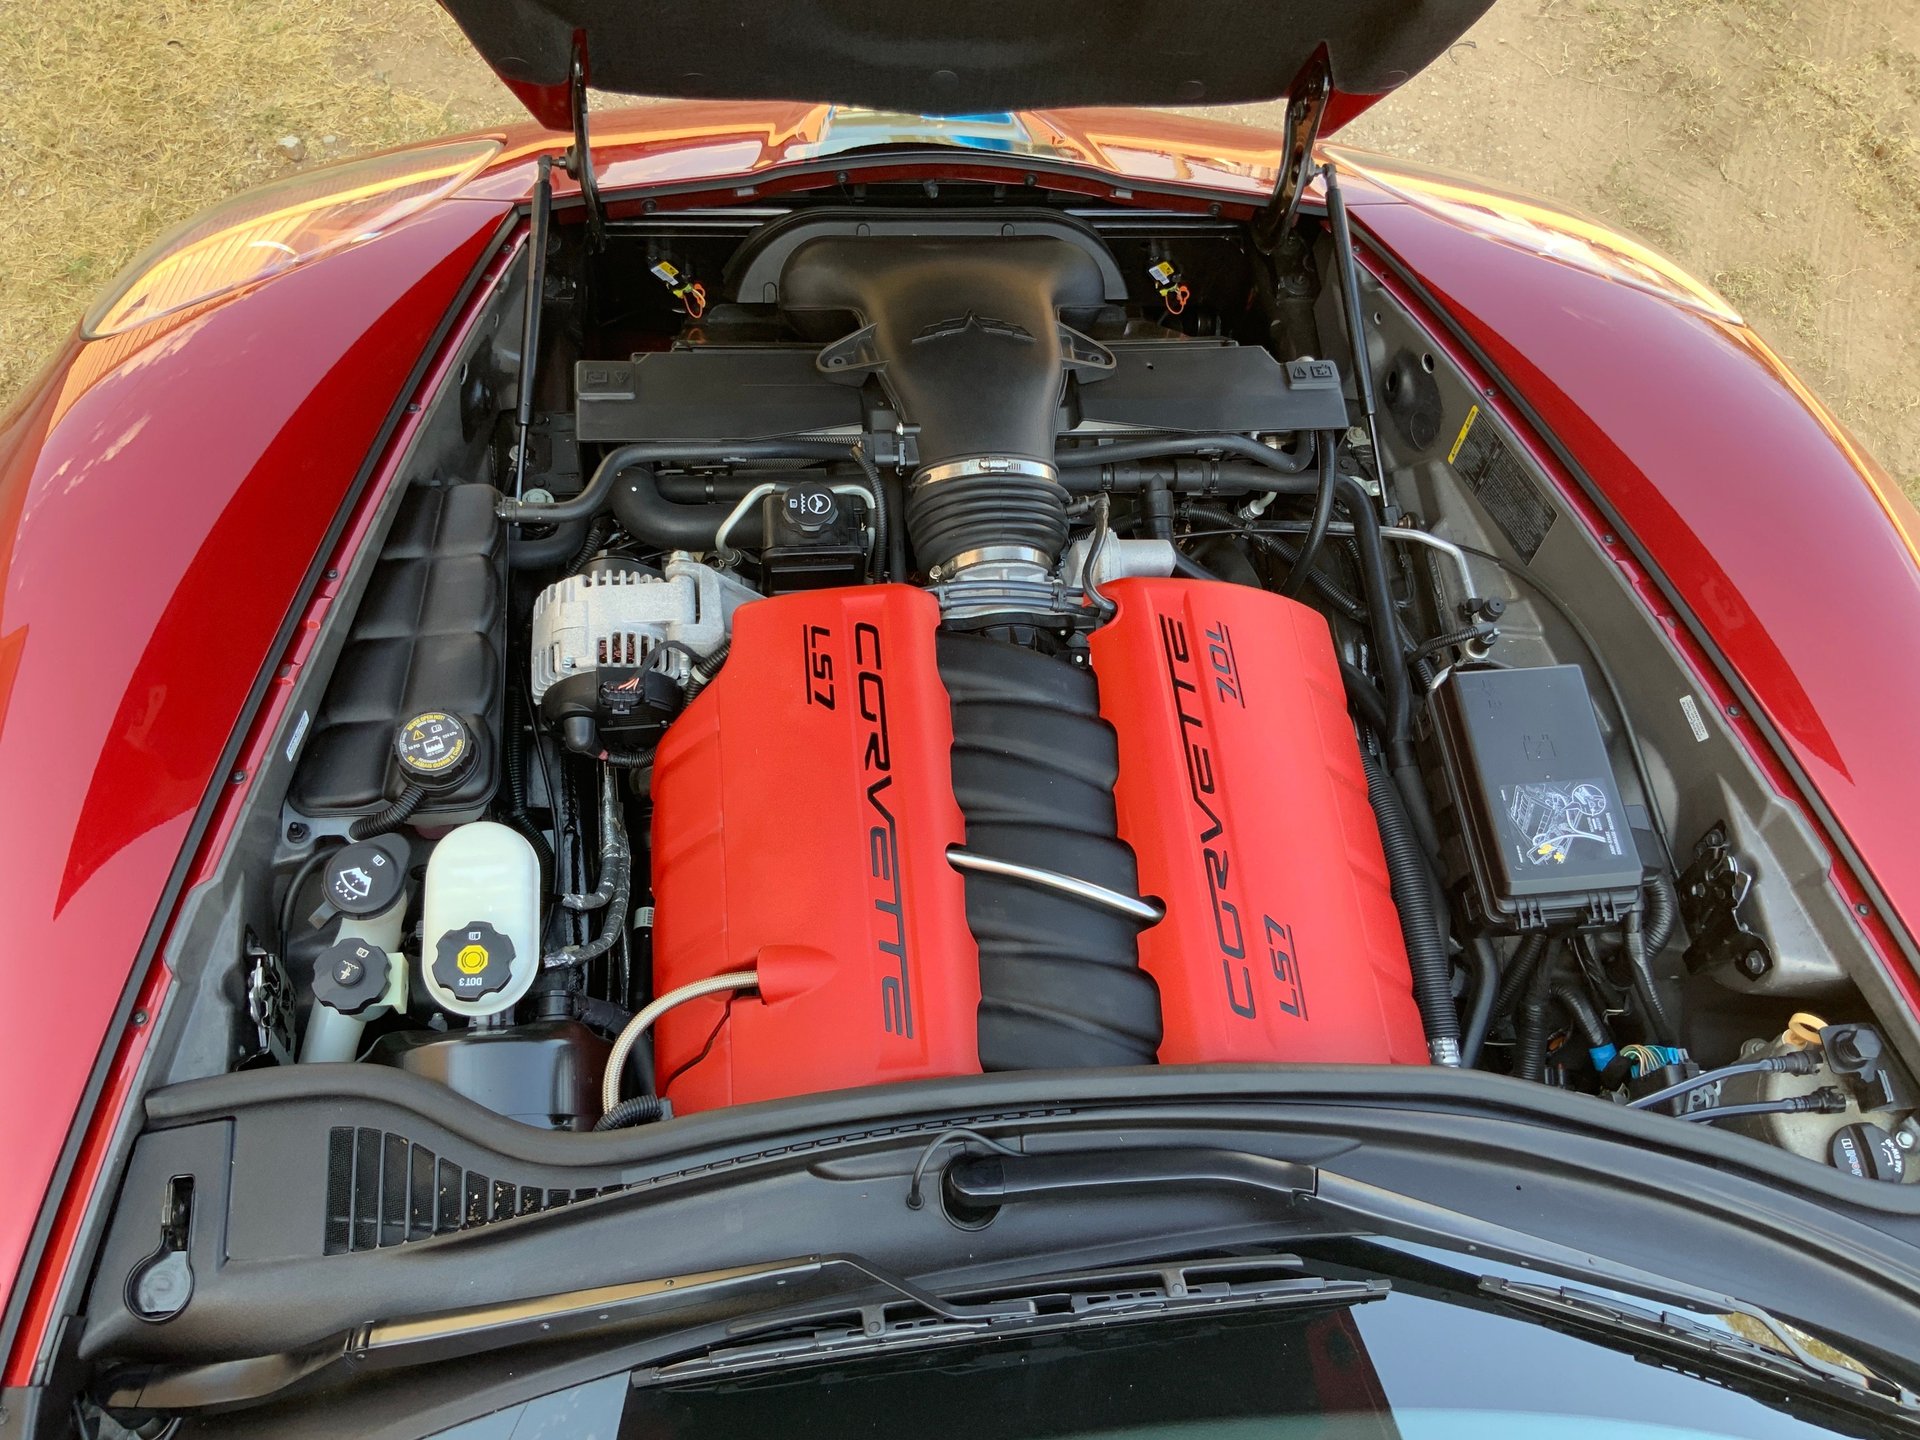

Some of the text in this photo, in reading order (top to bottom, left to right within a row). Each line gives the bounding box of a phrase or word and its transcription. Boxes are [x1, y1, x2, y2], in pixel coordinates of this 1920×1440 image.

[810, 625, 835, 711] LS7
[855, 622, 913, 1040] CORVETTE
[1159, 613, 1256, 1020] CORVETTE
[458, 977, 483, 987] DOT 3
[1263, 914, 1301, 1018] LS7
